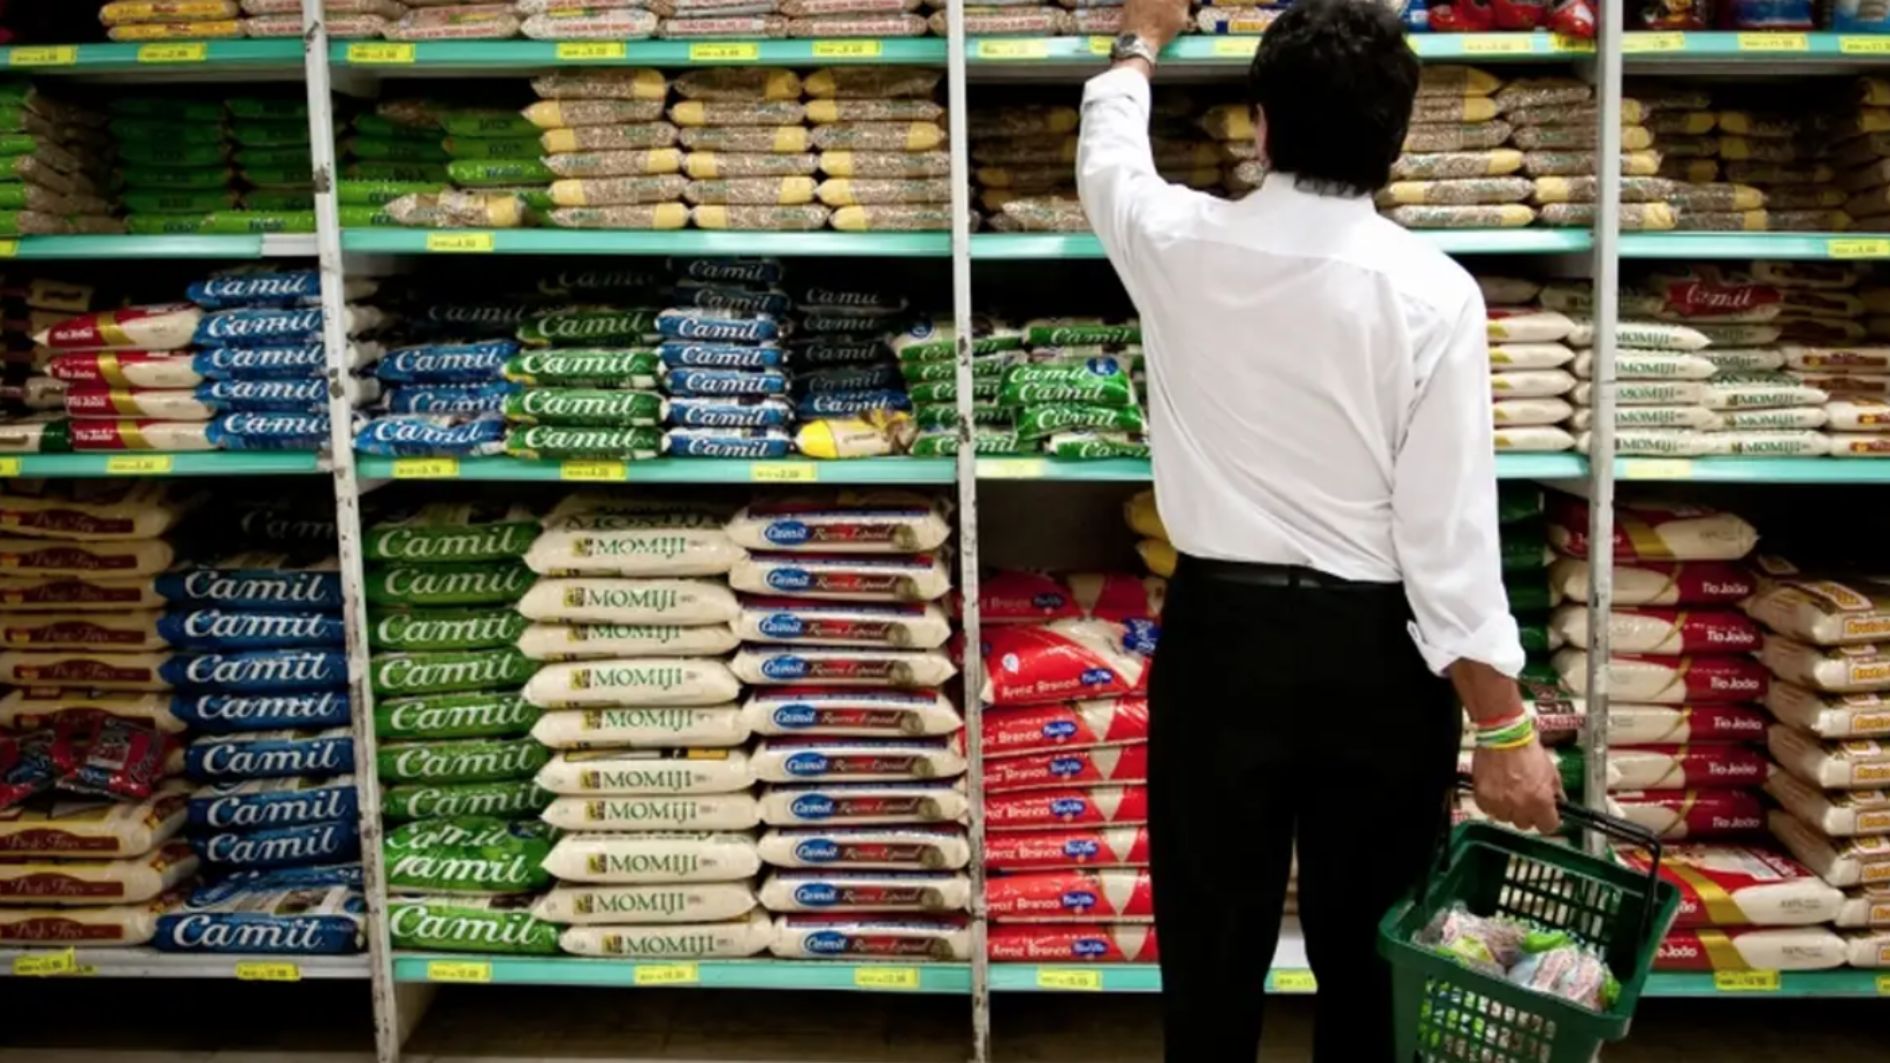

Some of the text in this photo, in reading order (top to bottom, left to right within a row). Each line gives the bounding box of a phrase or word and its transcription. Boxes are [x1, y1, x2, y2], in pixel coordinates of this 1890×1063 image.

[689, 260, 765, 282] Camil
[205, 275, 306, 296] Camil
[694, 288, 770, 311] Camil
[208, 306, 321, 338] Camil
[538, 312, 649, 338] Camil
[679, 316, 760, 340] Camil
[1051, 326, 1131, 346] Camil
[212, 344, 326, 369] Camil
[396, 348, 500, 372] Camil
[681, 345, 762, 367] Camil
[805, 342, 878, 361] Camil
[522, 352, 637, 375] Camil
[1010, 364, 1089, 384] Camil
[212, 378, 324, 399] Camil
[686, 371, 768, 393] Camil
[1018, 381, 1107, 403] Camil
[523, 388, 637, 415] Camil
[1619, 386, 1675, 401] MOMIJI
[685, 402, 767, 426] Camil
[1037, 406, 1119, 430] Camil
[1620, 409, 1675, 423] MOMIJI
[375, 421, 483, 444] Camil
[525, 425, 638, 450] Camil
[689, 435, 770, 457] Camil
[378, 526, 519, 558] Camil
[767, 525, 808, 539] Camil
[596, 537, 687, 558] MOMIJI
[185, 571, 328, 601] Camil
[385, 567, 523, 596] Camil
[768, 573, 809, 587] Camil
[588, 589, 677, 612] MOMIJI
[184, 609, 329, 638] Camil
[378, 611, 518, 644] Camil
[591, 625, 681, 644] MOMIJI
[761, 620, 802, 634] Camil
[187, 651, 331, 683] Camil
[379, 650, 519, 689] Camil
[763, 662, 805, 675] Camil
[594, 668, 683, 691] MOMIJI
[1037, 676, 1081, 692] Branco
[197, 692, 338, 719] Camil
[391, 697, 530, 731] Camil
[775, 709, 815, 723] Camil
[605, 709, 693, 731] MOMIJI
[998, 730, 1042, 744] Branco
[202, 738, 340, 773] Camil
[396, 743, 535, 778] Camil
[787, 757, 828, 771] Camil
[603, 770, 692, 791] MOMIJI
[207, 790, 347, 828] Camil
[407, 782, 548, 818] Camil
[793, 801, 833, 813] Camil
[608, 801, 697, 823] MOMIJI
[1007, 805, 1050, 818] Branco
[207, 826, 339, 863] Camil
[797, 846, 838, 858] Camil
[1019, 846, 1063, 858] Branco
[609, 854, 698, 875] MOMIJI
[596, 892, 686, 915] MOMIJI
[796, 888, 838, 901] Camil
[1016, 897, 1061, 910] Branco
[173, 912, 325, 950] Camil
[391, 904, 544, 945] Camil
[626, 936, 715, 956] MOMIJI
[806, 936, 847, 950] Camil
[1027, 940, 1073, 956] Branco
